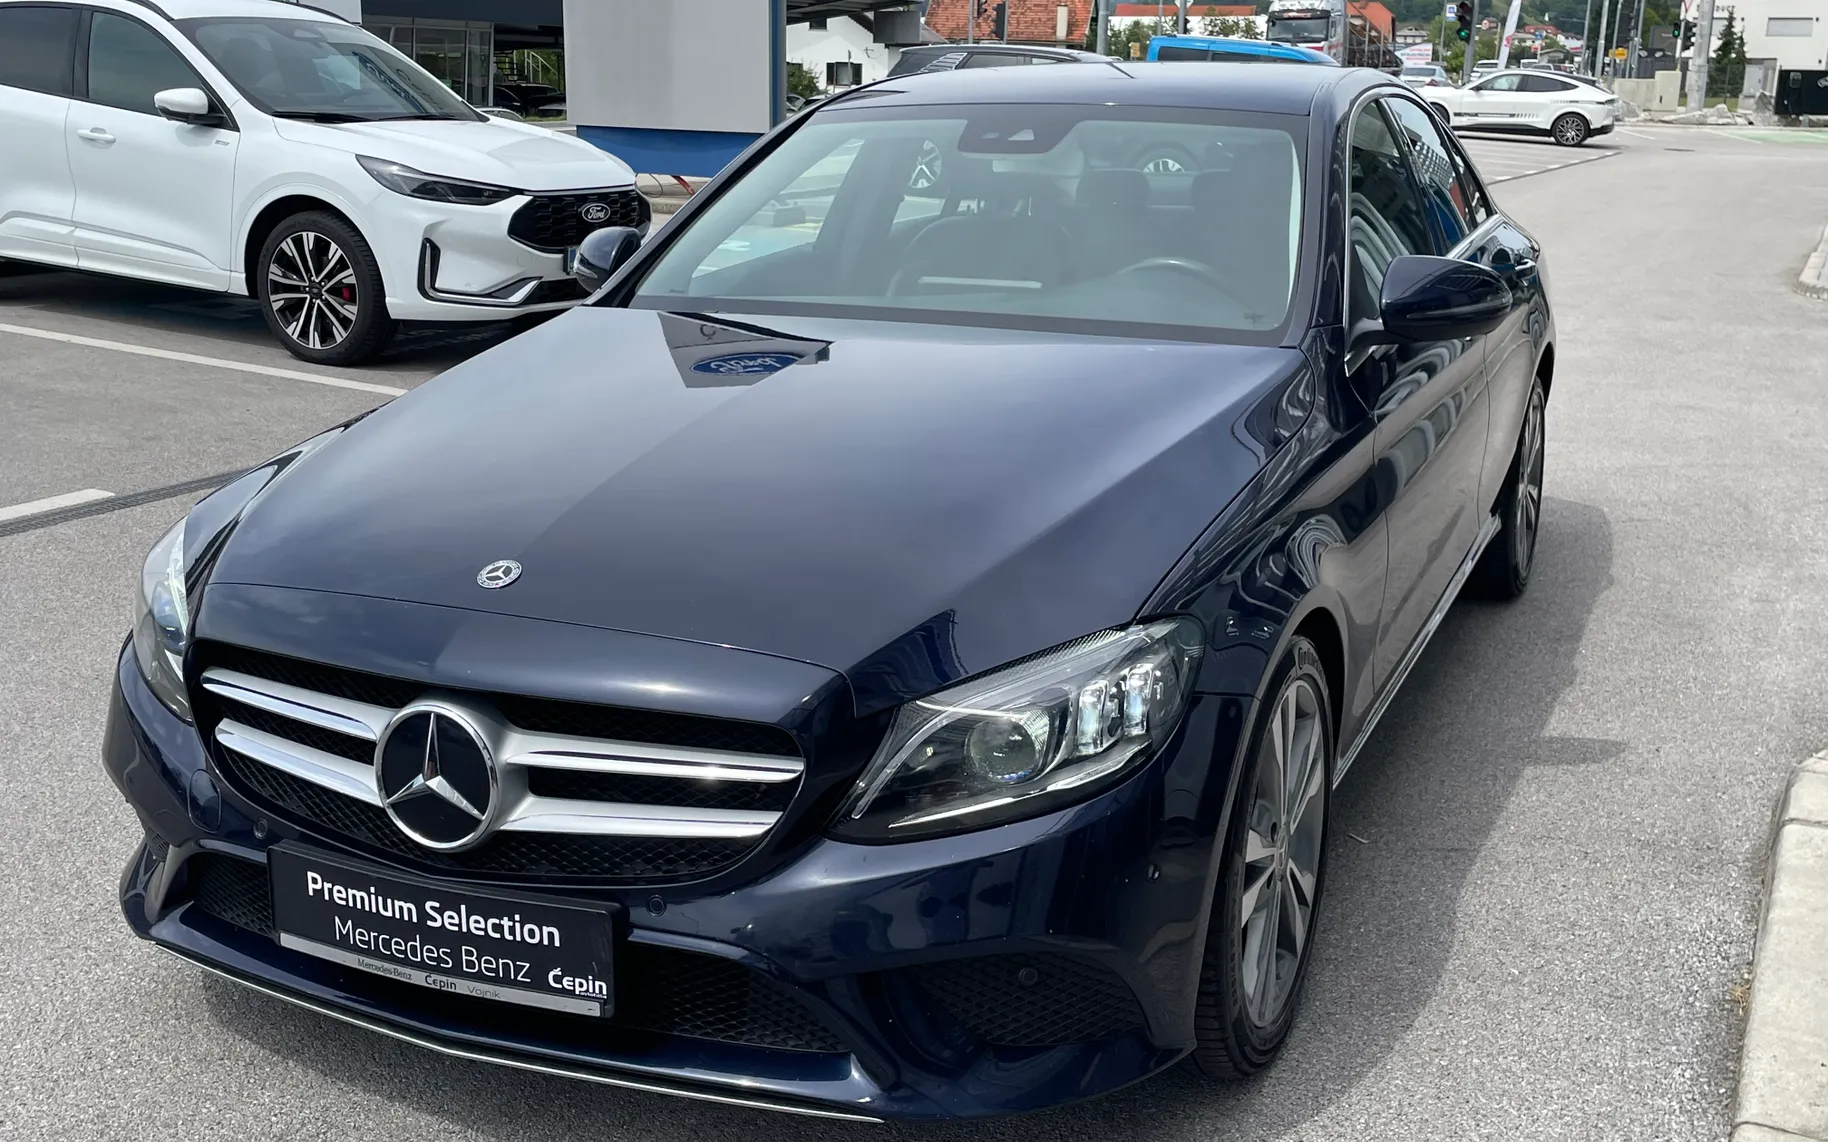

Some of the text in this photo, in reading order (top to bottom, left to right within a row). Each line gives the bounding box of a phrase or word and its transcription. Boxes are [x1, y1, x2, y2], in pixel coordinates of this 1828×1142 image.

[306, 870, 560, 947] Premium Selection
[334, 915, 531, 982] Mercedes Benz
[424, 972, 457, 990] Čepin
[467, 985, 501, 999] Vojnik
[547, 967, 607, 995] Čepin
